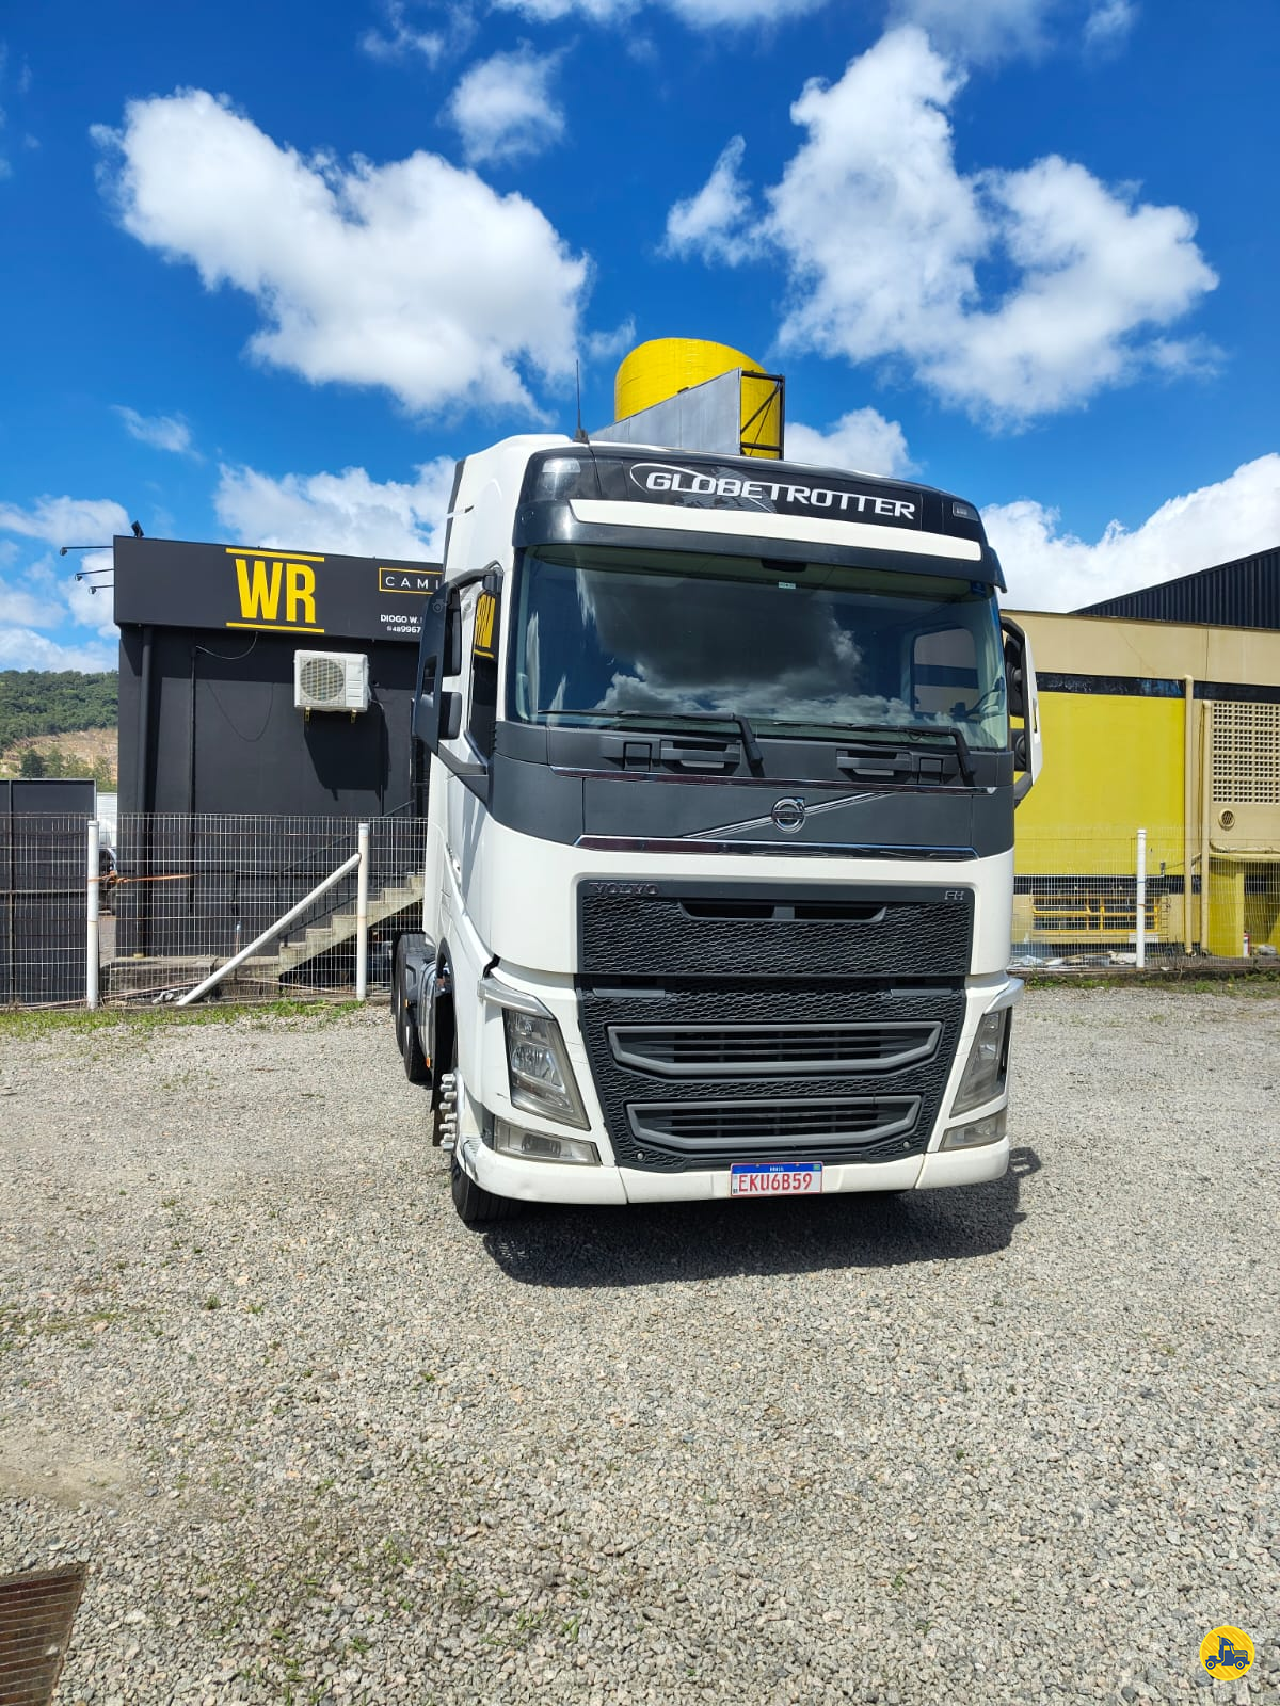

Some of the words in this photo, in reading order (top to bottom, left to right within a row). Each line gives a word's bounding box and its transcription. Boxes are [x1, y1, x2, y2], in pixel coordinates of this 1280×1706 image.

[646, 471, 915, 519] GLOBETROTTER
[235, 558, 317, 624] WR
[380, 614, 407, 624] DIOGO
[588, 882, 659, 895] VOLVO
[738, 1172, 813, 1193] EKU6B59
